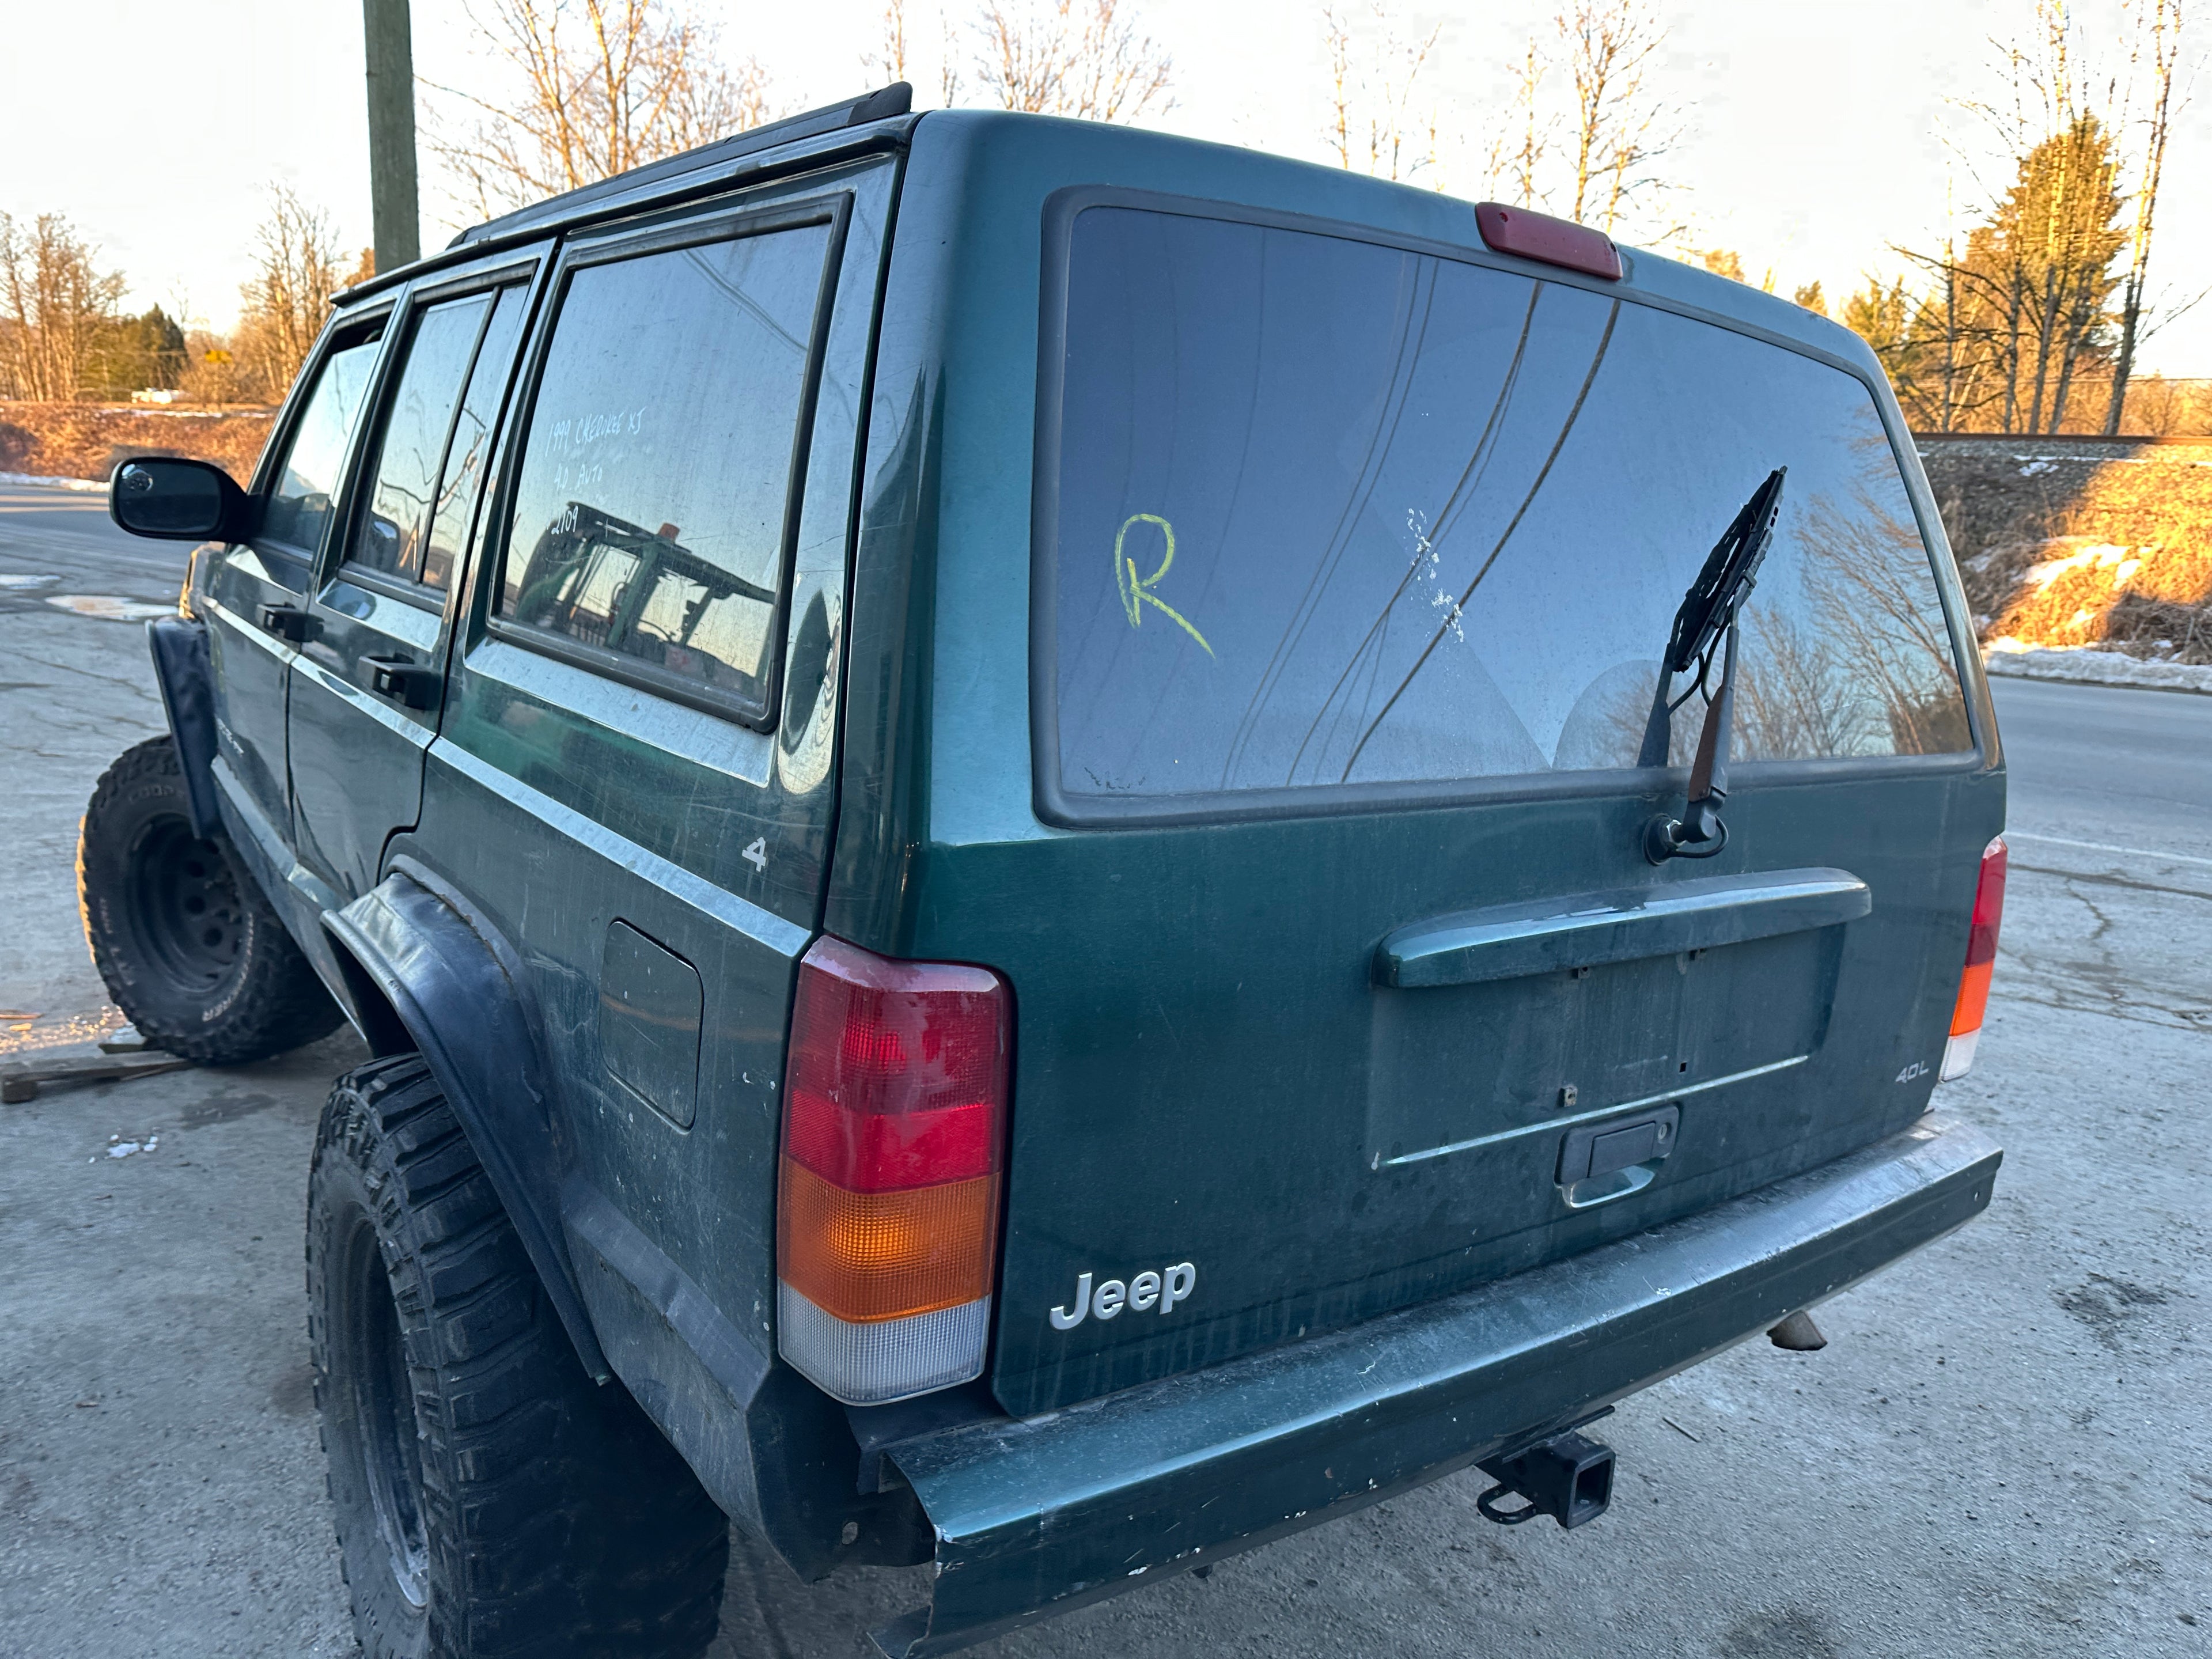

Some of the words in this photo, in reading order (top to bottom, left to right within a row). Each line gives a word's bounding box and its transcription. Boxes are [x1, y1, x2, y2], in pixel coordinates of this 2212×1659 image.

[545, 419, 571, 457] 1999
[627, 407, 648, 435] XJ
[1115, 514, 1216, 660] R
[742, 837, 766, 872] 4
[1050, 1262, 1196, 1330] Jeep
